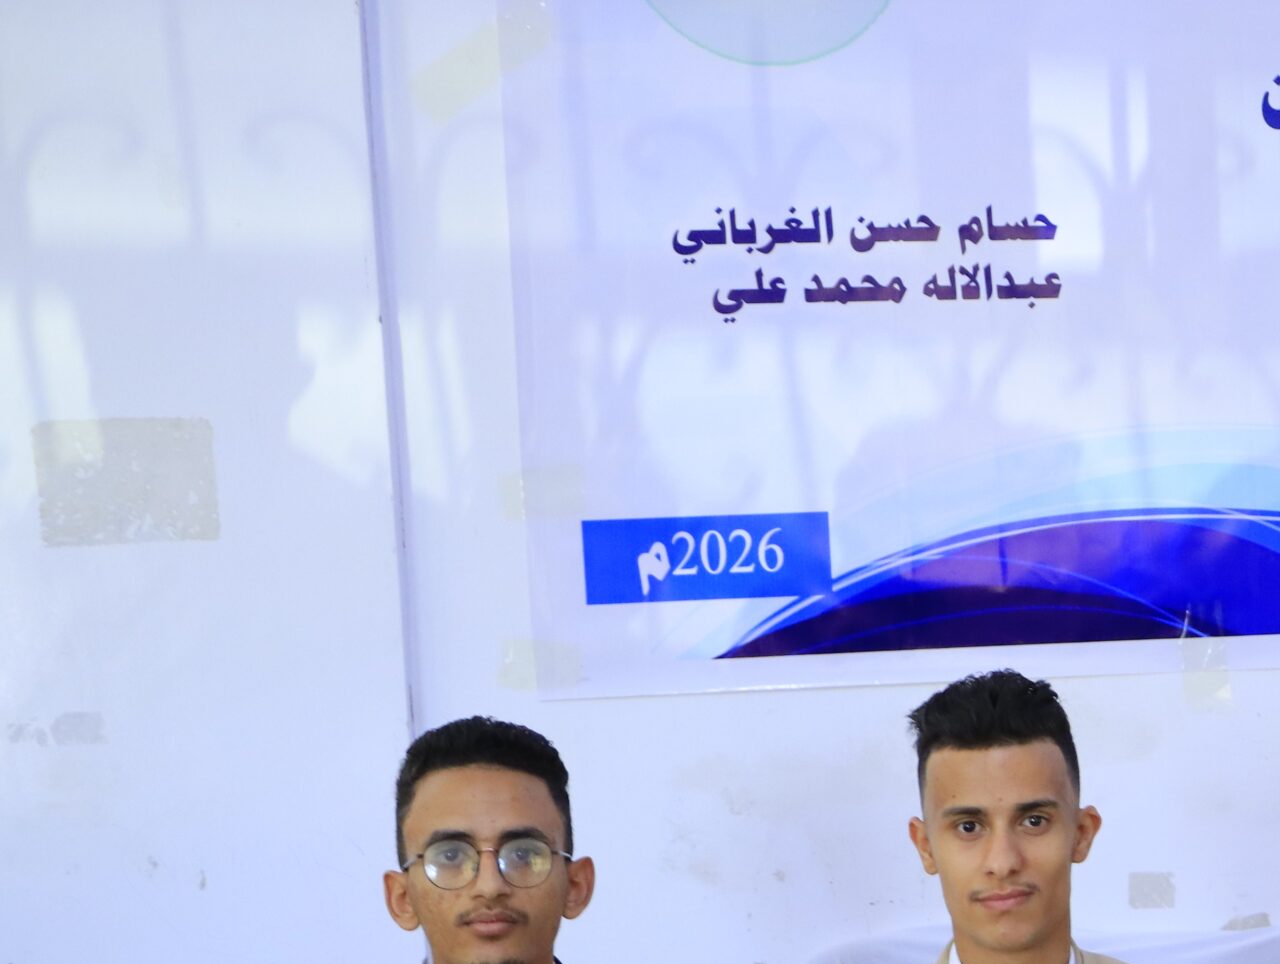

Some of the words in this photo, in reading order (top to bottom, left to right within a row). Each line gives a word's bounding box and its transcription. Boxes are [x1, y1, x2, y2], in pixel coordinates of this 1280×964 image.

[672, 205, 834, 265] الغرباني
[849, 211, 941, 253] حسن
[957, 204, 1058, 255] حسام
[712, 267, 788, 324] علي
[803, 274, 908, 305] محمد
